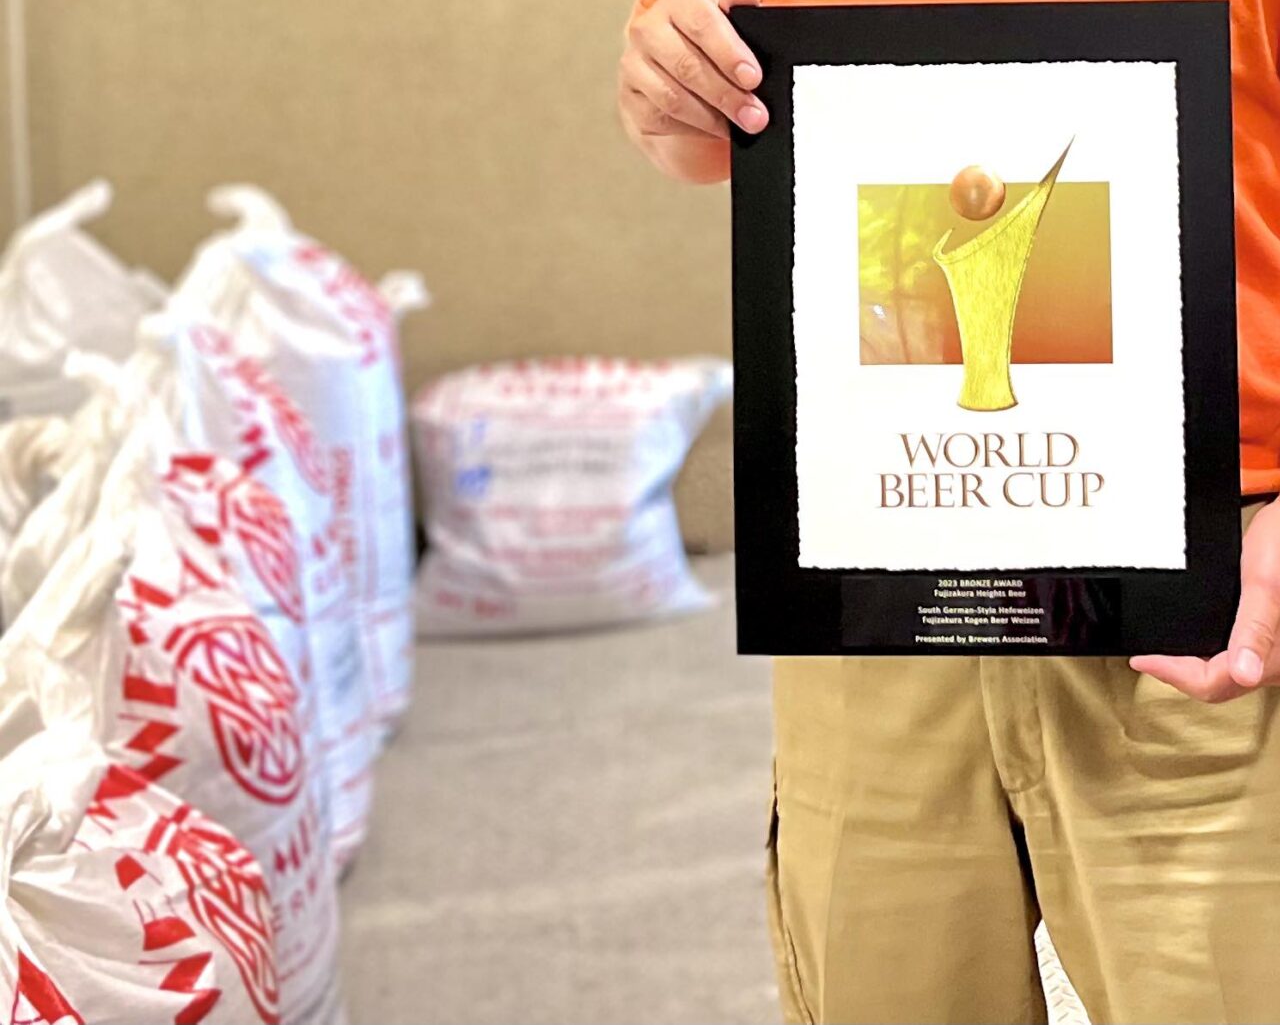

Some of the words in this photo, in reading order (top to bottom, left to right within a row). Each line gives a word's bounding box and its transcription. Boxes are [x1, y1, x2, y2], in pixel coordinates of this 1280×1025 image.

[897, 431, 1081, 469] WORLD
[877, 471, 992, 509] BEER
[1002, 471, 1106, 509] CUP
[937, 579, 958, 588] 2023
[960, 579, 991, 588] BRONZE
[993, 579, 1023, 587] AWARD
[934, 589, 974, 599] Fujizakura
[976, 589, 1007, 599] Heights
[1008, 589, 1027, 598] Beer
[917, 606, 941, 615] South
[943, 605, 997, 616] German-Style
[922, 616, 962, 626] Fujizakura
[964, 616, 989, 626] Kogen
[990, 616, 1009, 625] Beer
[1011, 616, 1040, 625] Weizen
[915, 635, 955, 644] Presented
[956, 635, 967, 645] by
[968, 635, 1000, 644] Brewers
[1002, 635, 1048, 644] Association
